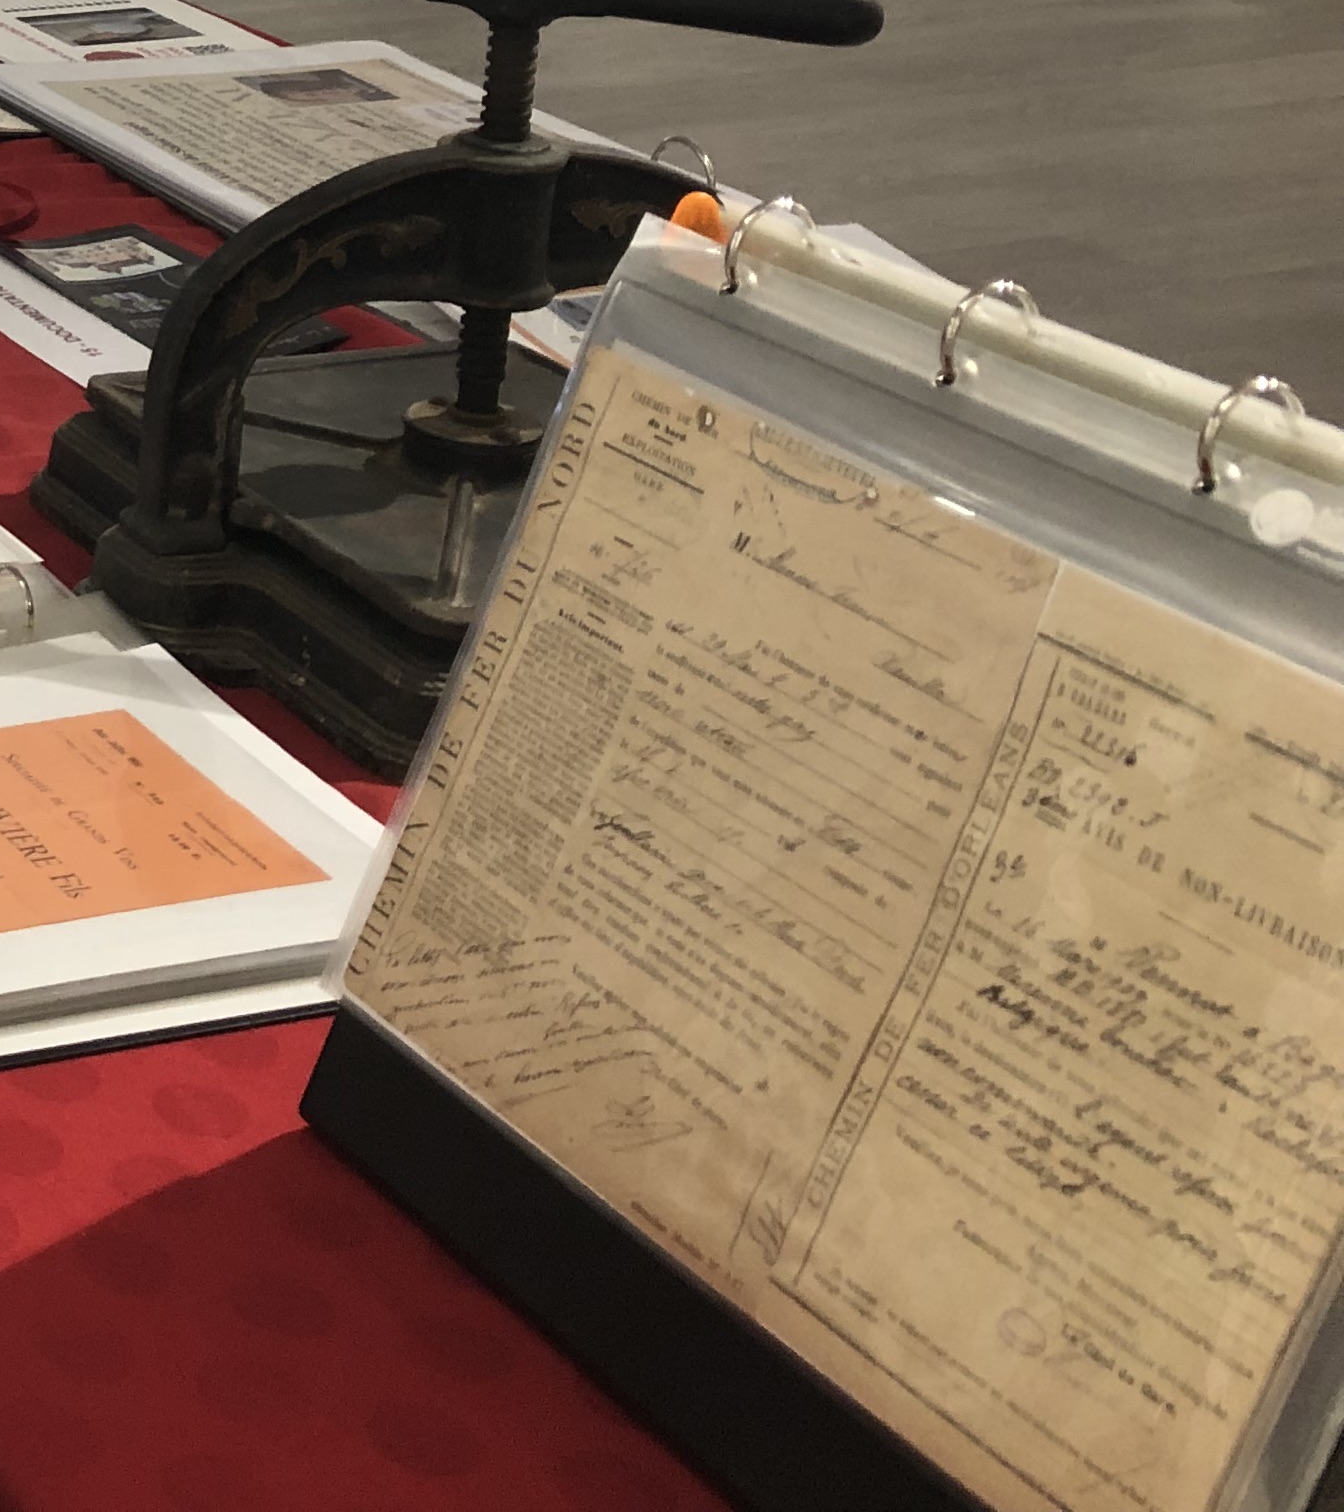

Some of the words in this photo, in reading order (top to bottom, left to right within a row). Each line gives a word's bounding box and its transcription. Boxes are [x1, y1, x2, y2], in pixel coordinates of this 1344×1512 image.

[348, 816, 430, 976] CHEMIN
[427, 731, 463, 790] DE
[460, 630, 508, 711] FER
[537, 402, 596, 519] NORD
[48, 871, 92, 900] Fils
